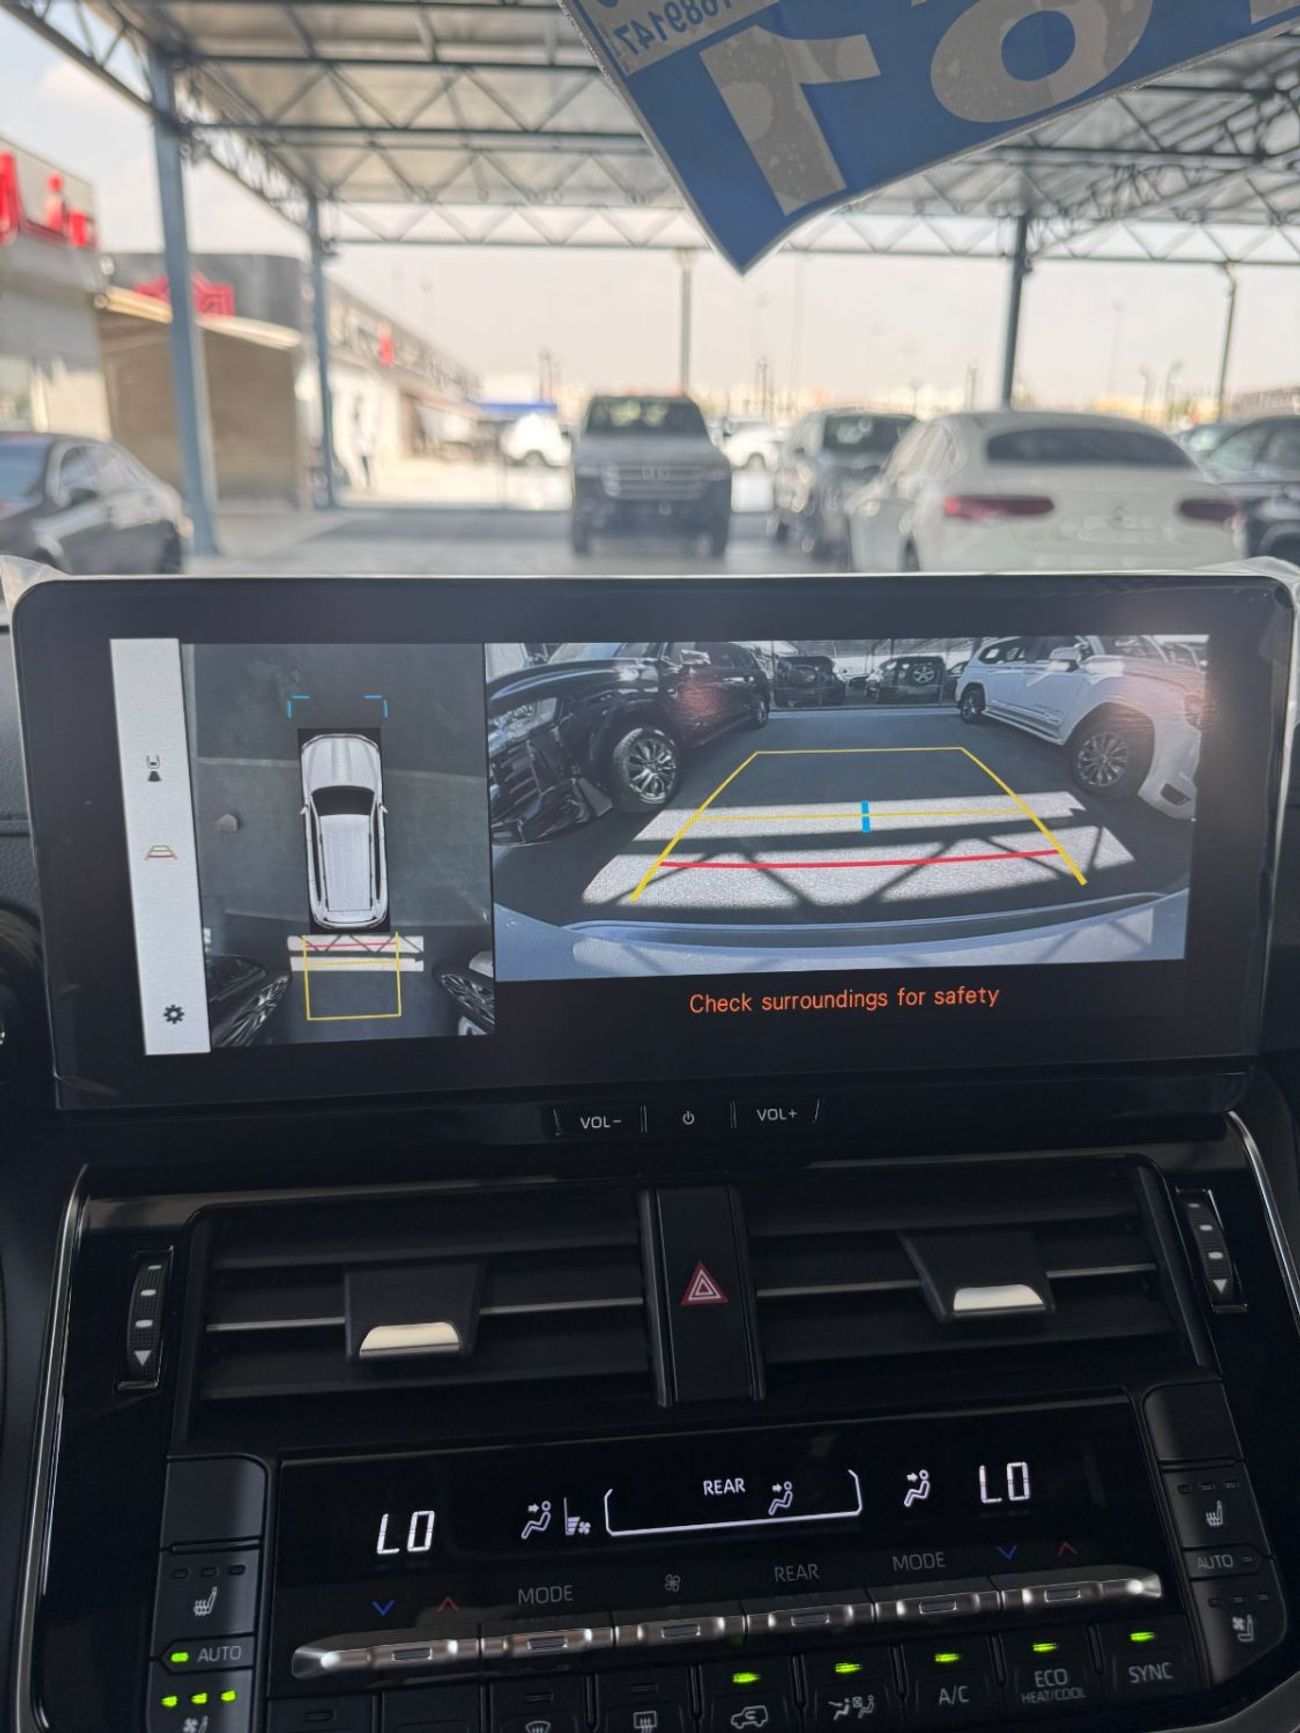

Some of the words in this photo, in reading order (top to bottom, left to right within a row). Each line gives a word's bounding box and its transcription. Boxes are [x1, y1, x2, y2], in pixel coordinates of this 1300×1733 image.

[689, 992, 752, 1014] Check
[761, 989, 888, 1012] surroundings
[897, 987, 926, 1006] for
[934, 985, 1000, 1007] safety
[756, 1107, 798, 1122] VOL+
[703, 1477, 746, 1496] REAR
[978, 1461, 1031, 1504] LO
[376, 1510, 436, 1555] LO
[892, 1551, 946, 1570] MODE
[1197, 1553, 1234, 1569] AUTO
[774, 1563, 820, 1582] REAR
[518, 1584, 573, 1605] MODE
[197, 1645, 242, 1663] AUTO
[1034, 1668, 1069, 1688] ECO
[1128, 1661, 1173, 1684] SYNC
[938, 1685, 971, 1706] A/C
[1020, 1686, 1087, 1704] HEAT/COOL
